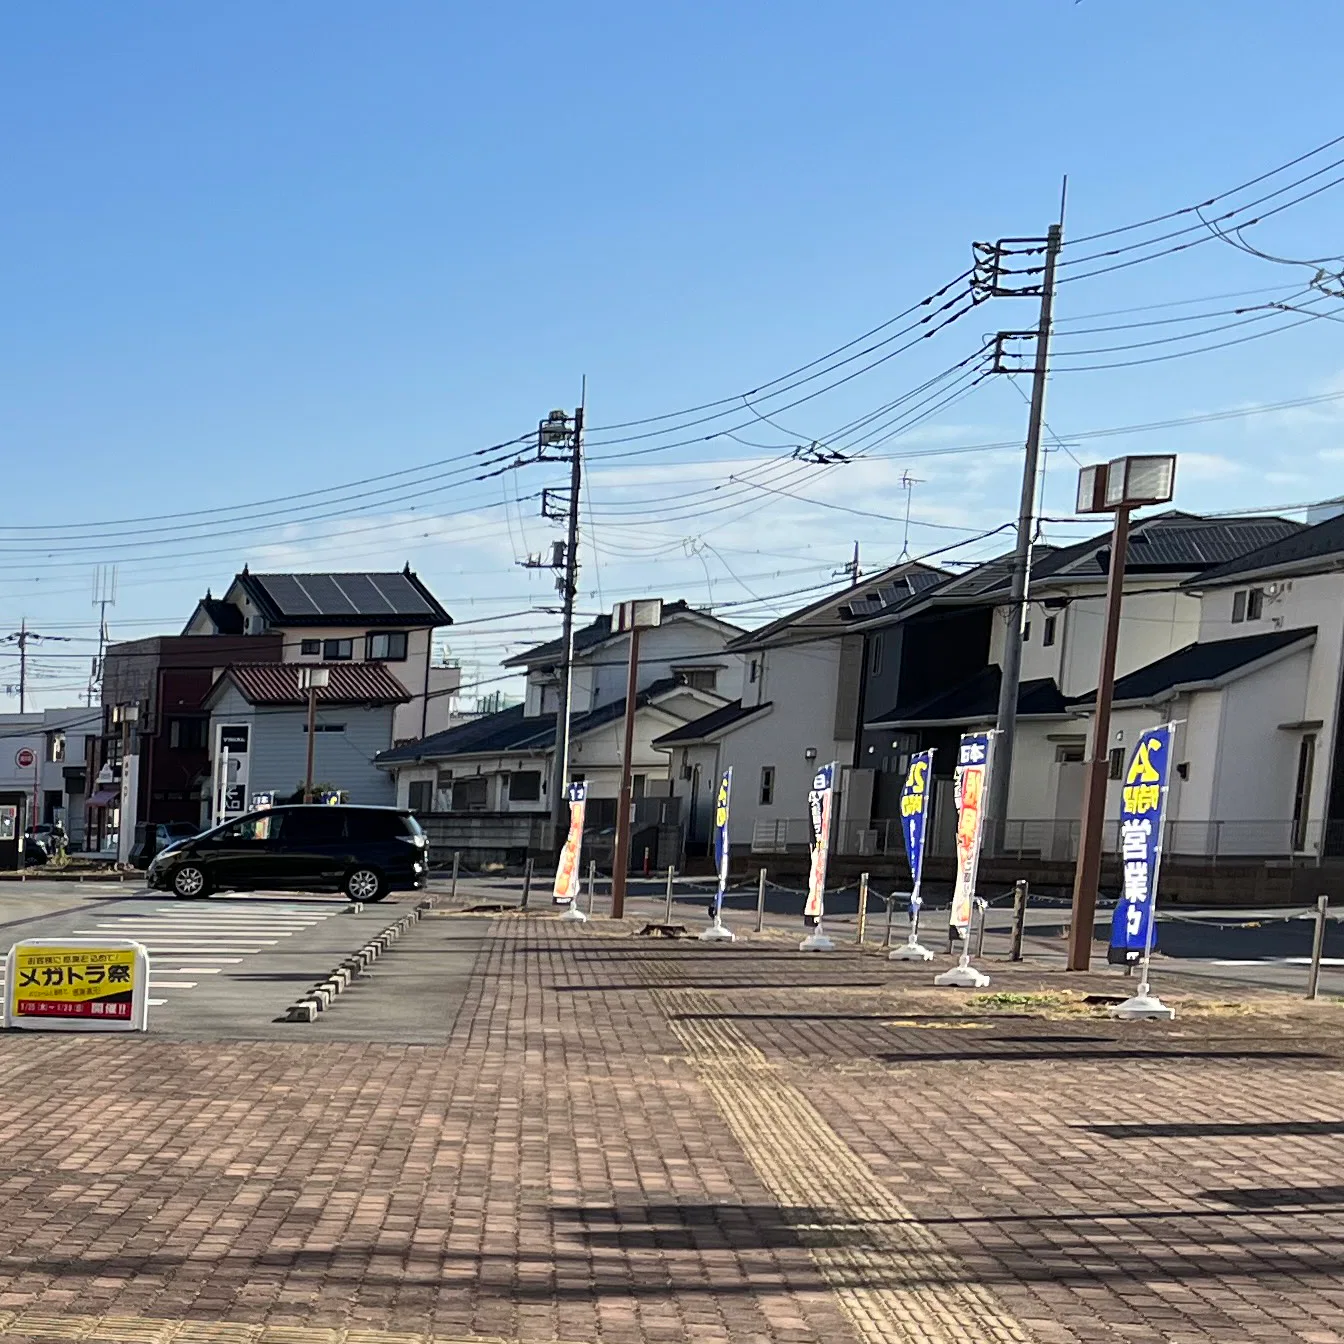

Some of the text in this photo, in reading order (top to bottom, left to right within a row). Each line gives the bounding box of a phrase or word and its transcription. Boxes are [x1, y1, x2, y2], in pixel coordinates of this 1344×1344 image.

[18, 964, 131, 987] メガトラ祭
